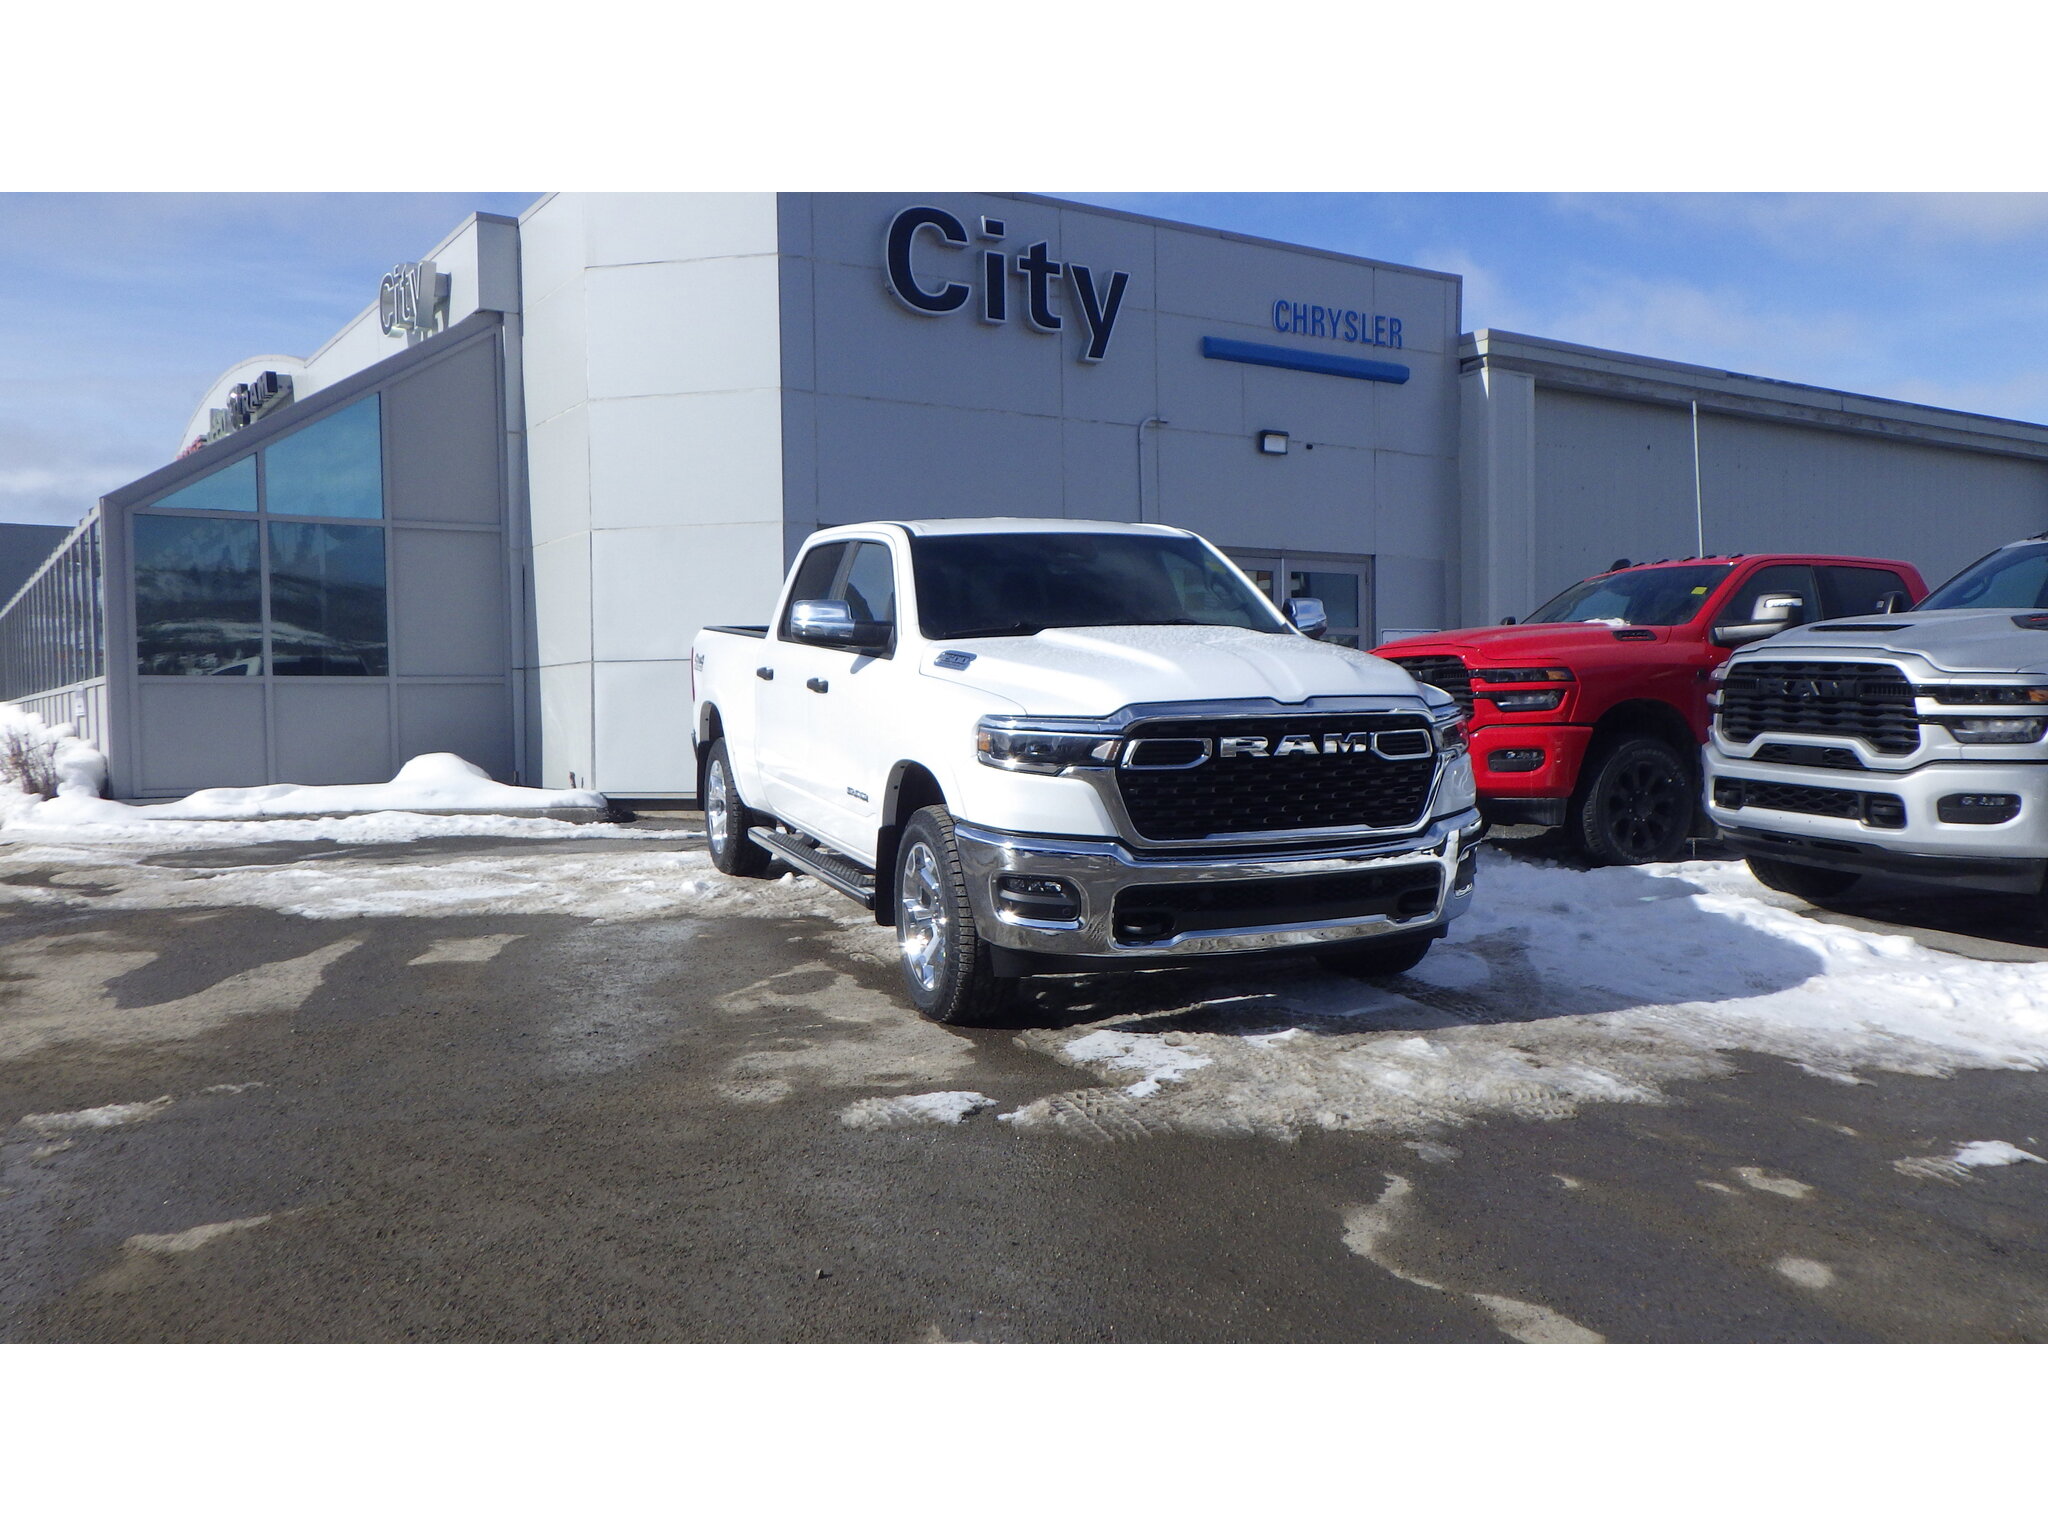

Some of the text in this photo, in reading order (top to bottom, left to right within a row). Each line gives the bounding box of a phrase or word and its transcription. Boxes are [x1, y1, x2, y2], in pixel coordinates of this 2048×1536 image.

[379, 261, 432, 336] City
[886, 205, 1130, 363] City
[1273, 299, 1403, 349] CHRYSLER
[1220, 731, 1367, 758] RAM
